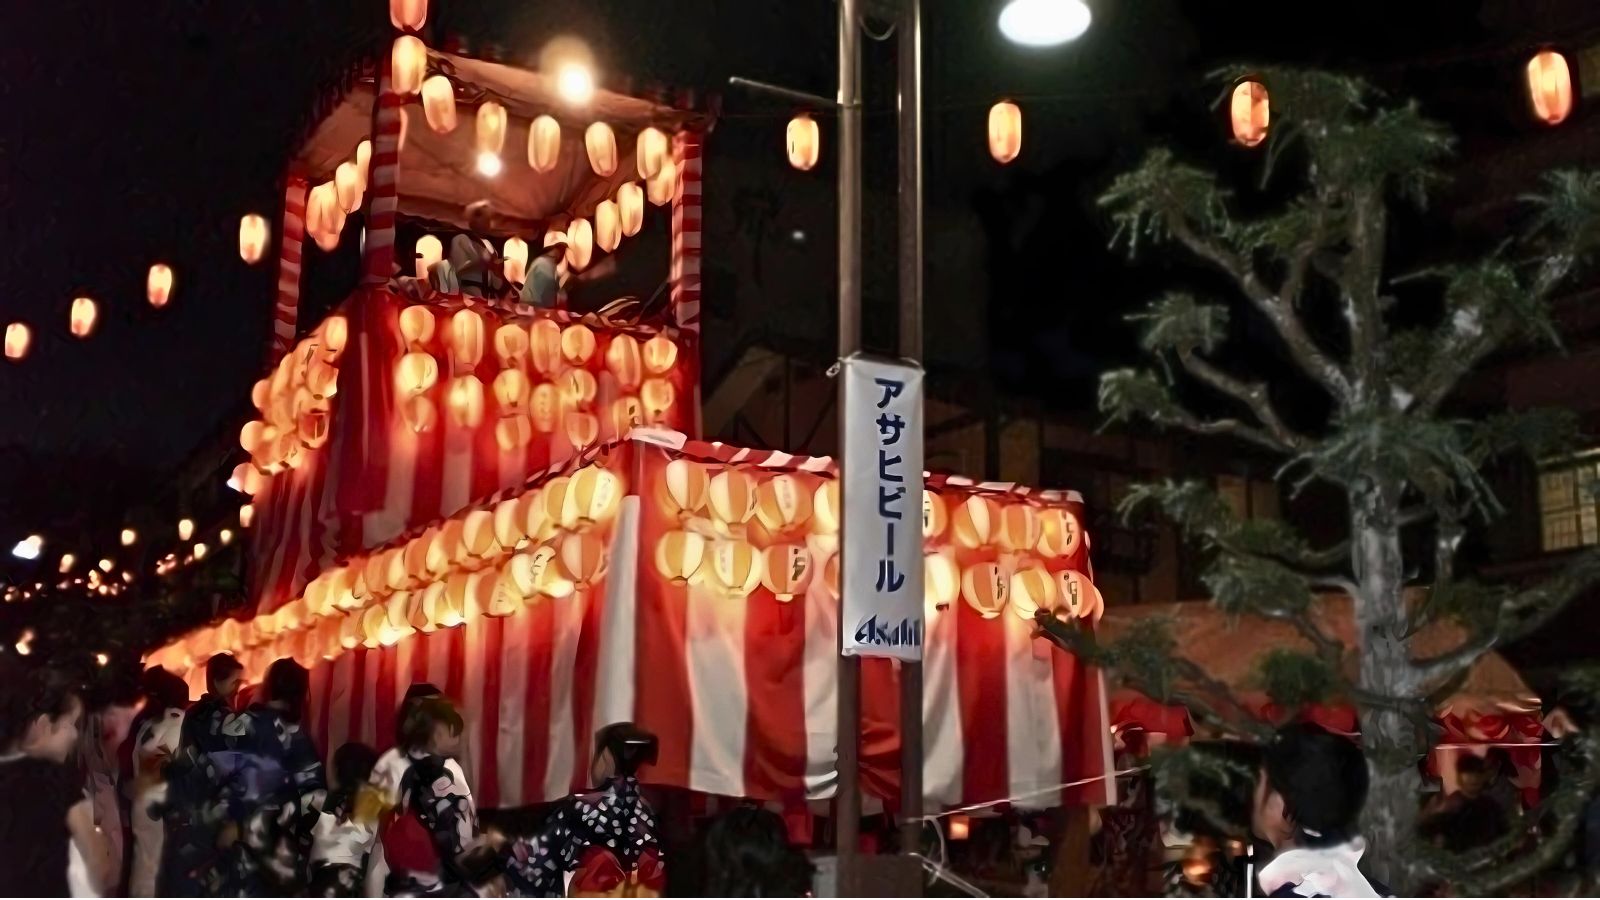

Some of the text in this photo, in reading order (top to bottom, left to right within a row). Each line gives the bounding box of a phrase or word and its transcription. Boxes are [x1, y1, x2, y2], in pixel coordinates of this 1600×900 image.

[874, 377, 906, 593] アサヒビール
[854, 614, 921, 647] Asahi
